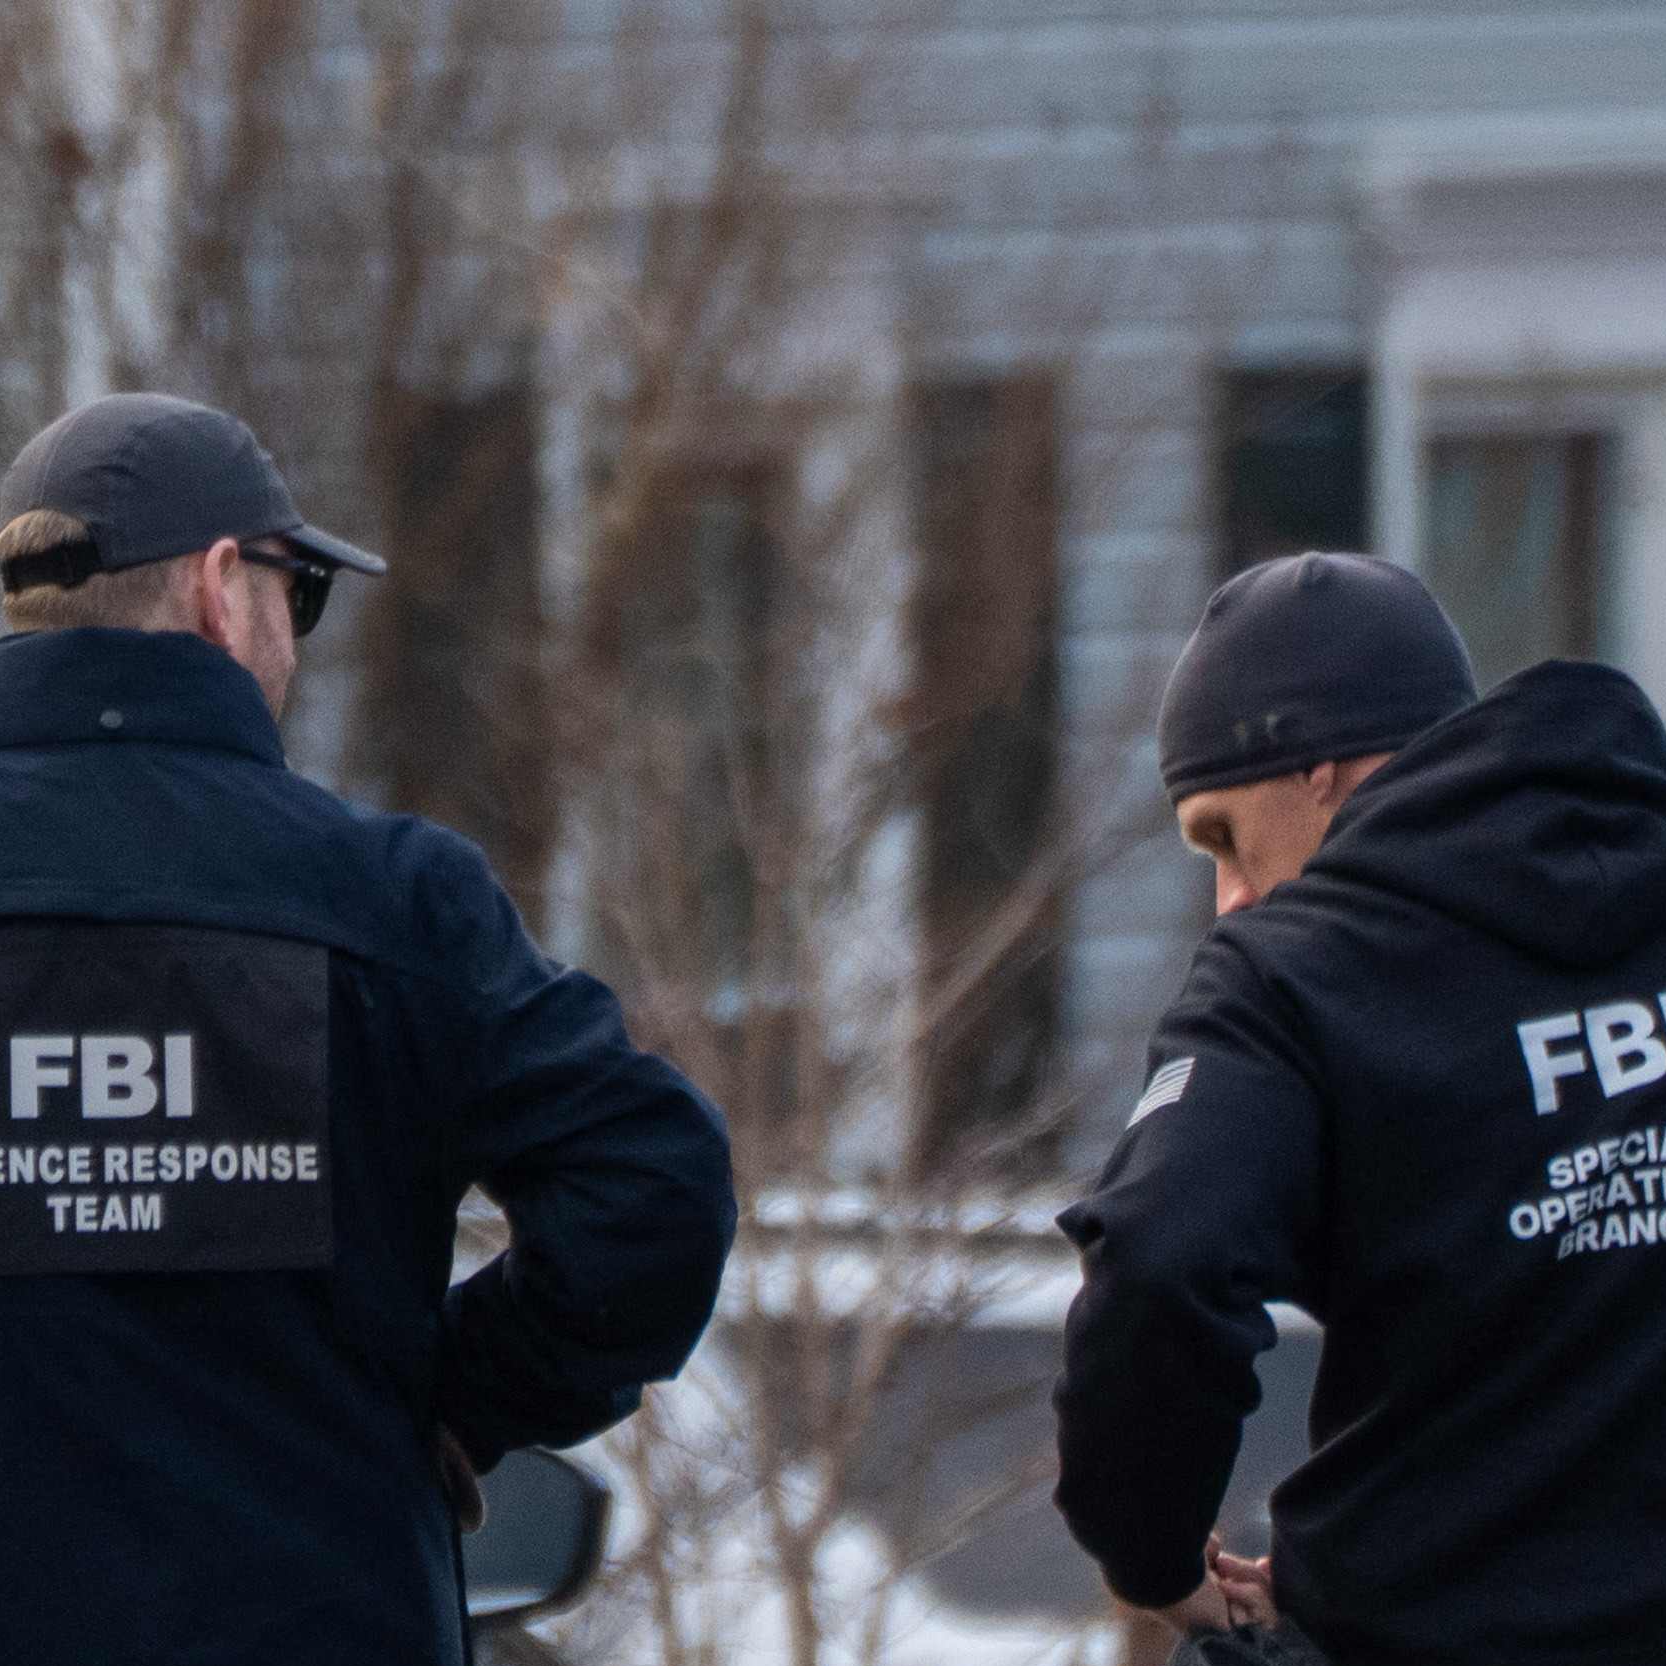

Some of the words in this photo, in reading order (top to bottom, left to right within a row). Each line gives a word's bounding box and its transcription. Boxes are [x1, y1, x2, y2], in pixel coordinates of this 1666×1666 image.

[9, 1033, 194, 1119] FBI
[103, 1143, 319, 1183] RESPONSE
[46, 1193, 163, 1233] TEAM
